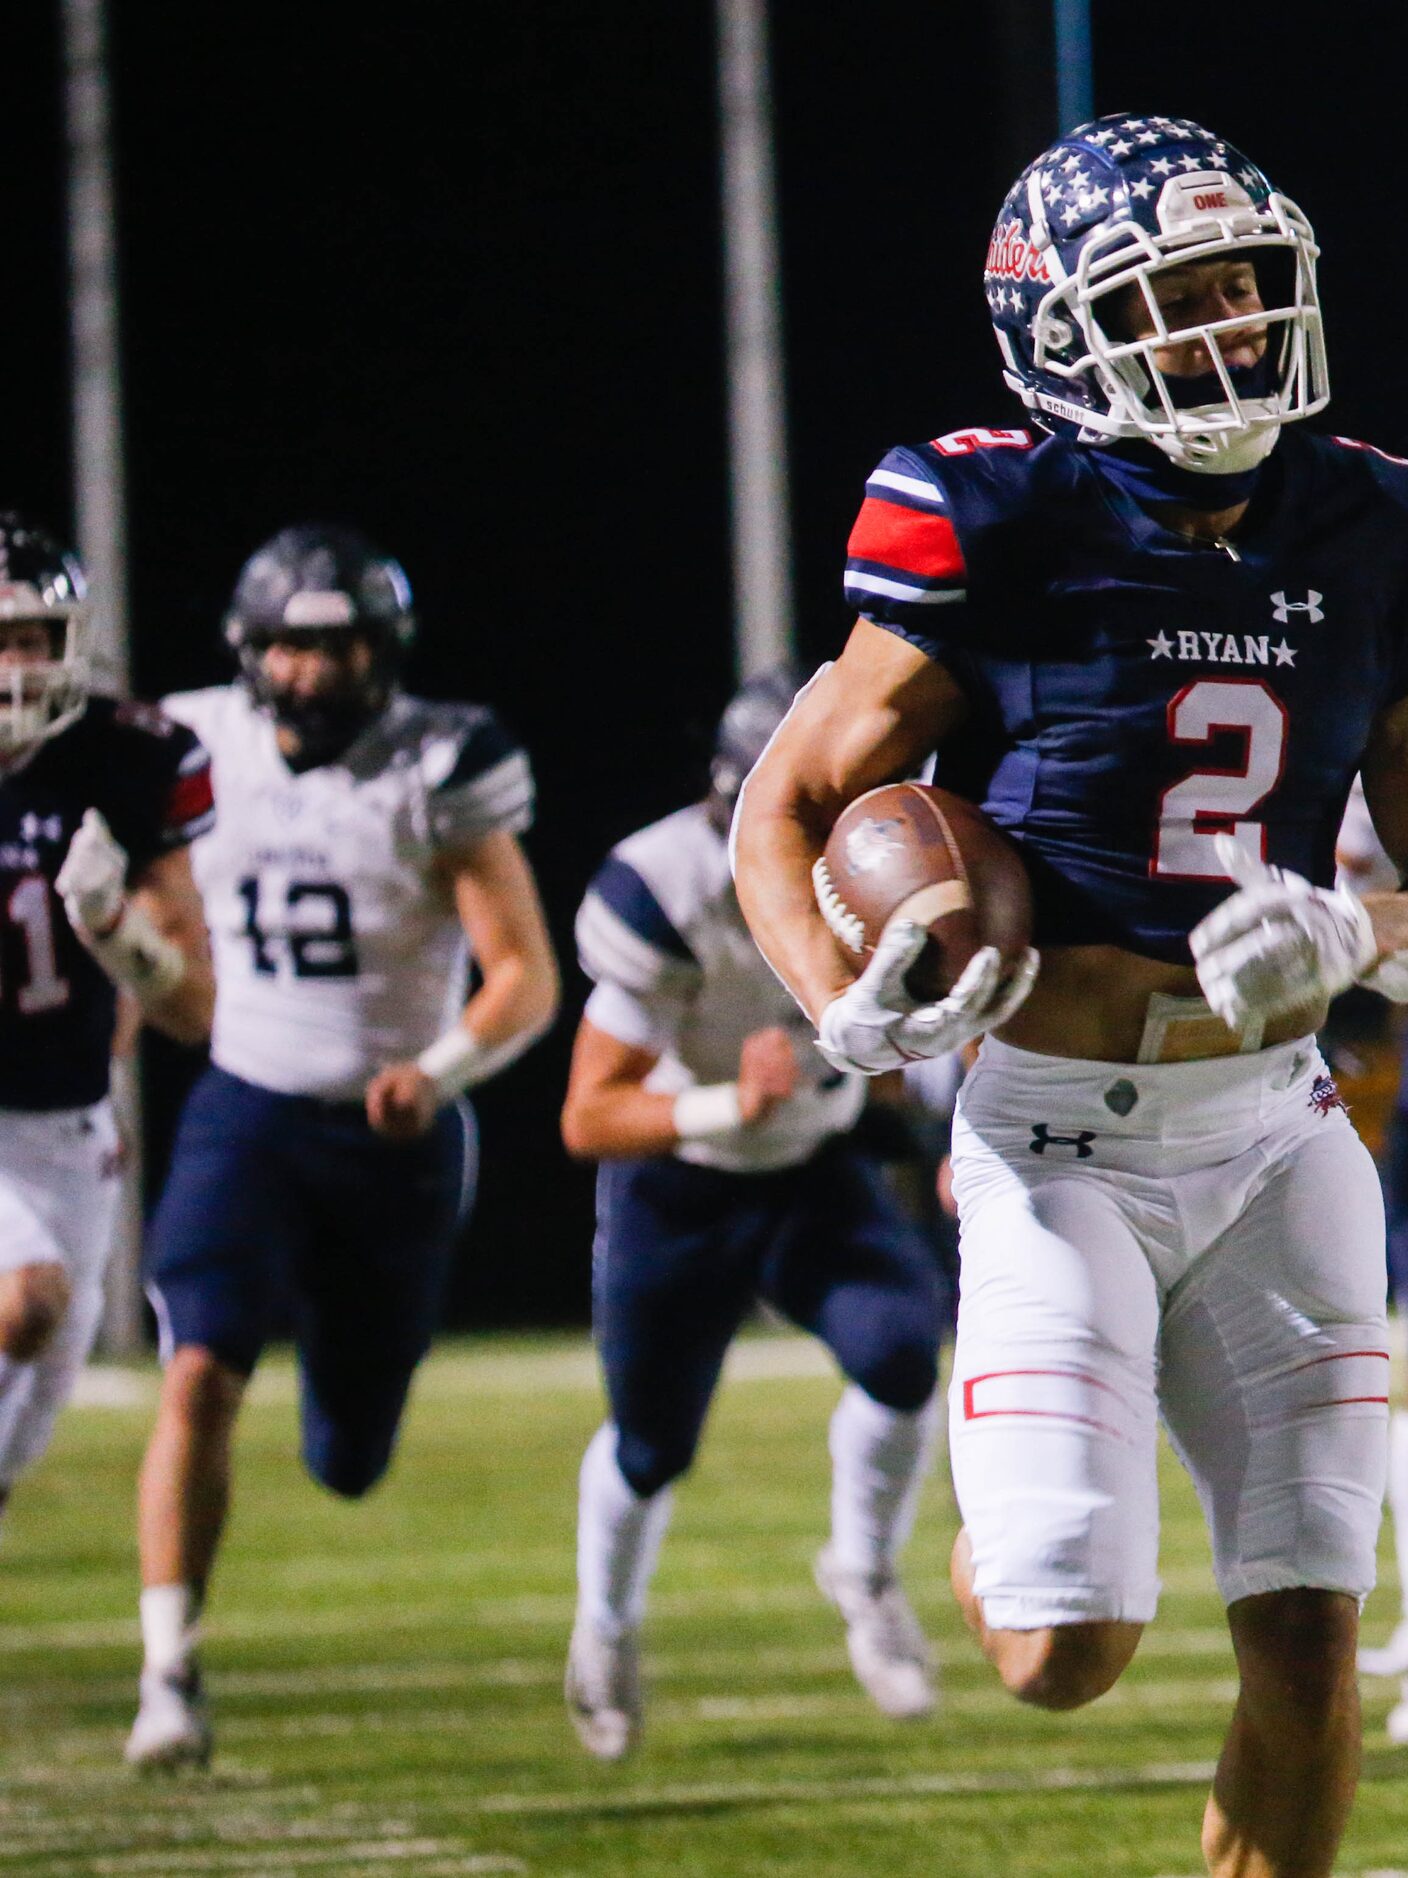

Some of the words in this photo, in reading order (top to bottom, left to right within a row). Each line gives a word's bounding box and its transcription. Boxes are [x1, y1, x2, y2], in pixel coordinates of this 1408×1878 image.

[1193, 191, 1229, 211] ONE
[1176, 629, 1270, 666] RYAN
[1148, 676, 1290, 886] 2
[237, 872, 359, 978] 12
